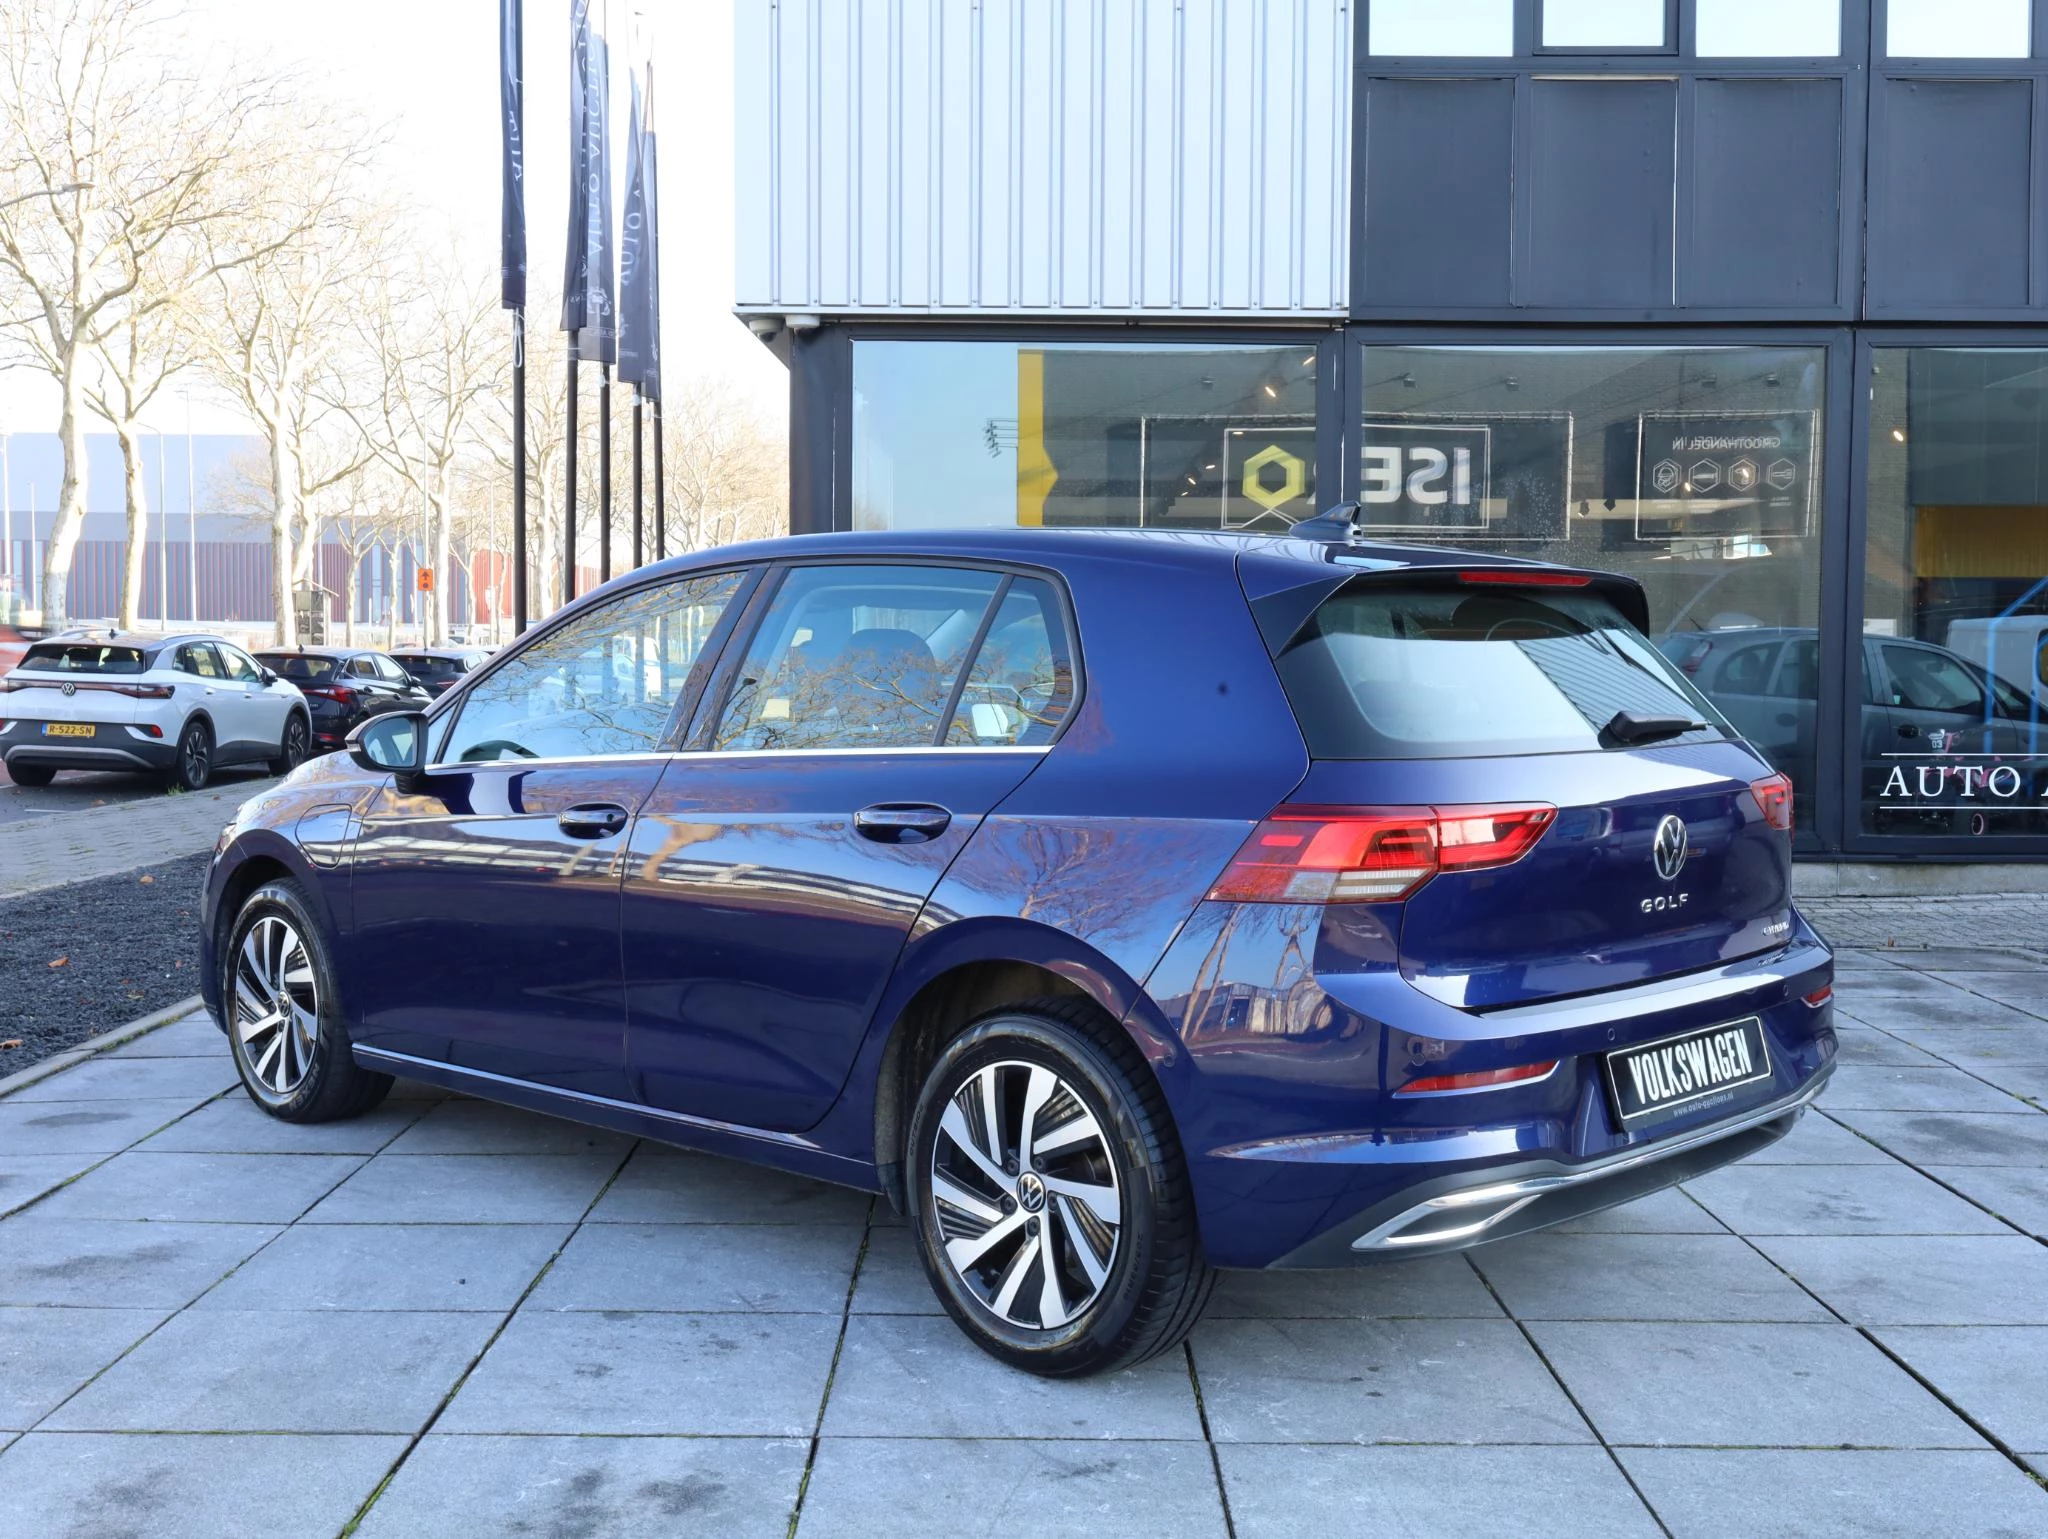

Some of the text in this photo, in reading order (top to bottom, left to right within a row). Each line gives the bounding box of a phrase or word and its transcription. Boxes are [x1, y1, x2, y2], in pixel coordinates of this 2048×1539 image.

[49, 725, 92, 735] R-522-SN
[1880, 765, 2020, 797] AUTO
[1640, 893, 1688, 913] GOLF
[1627, 1028, 1753, 1104] VOLKSWAGEN
